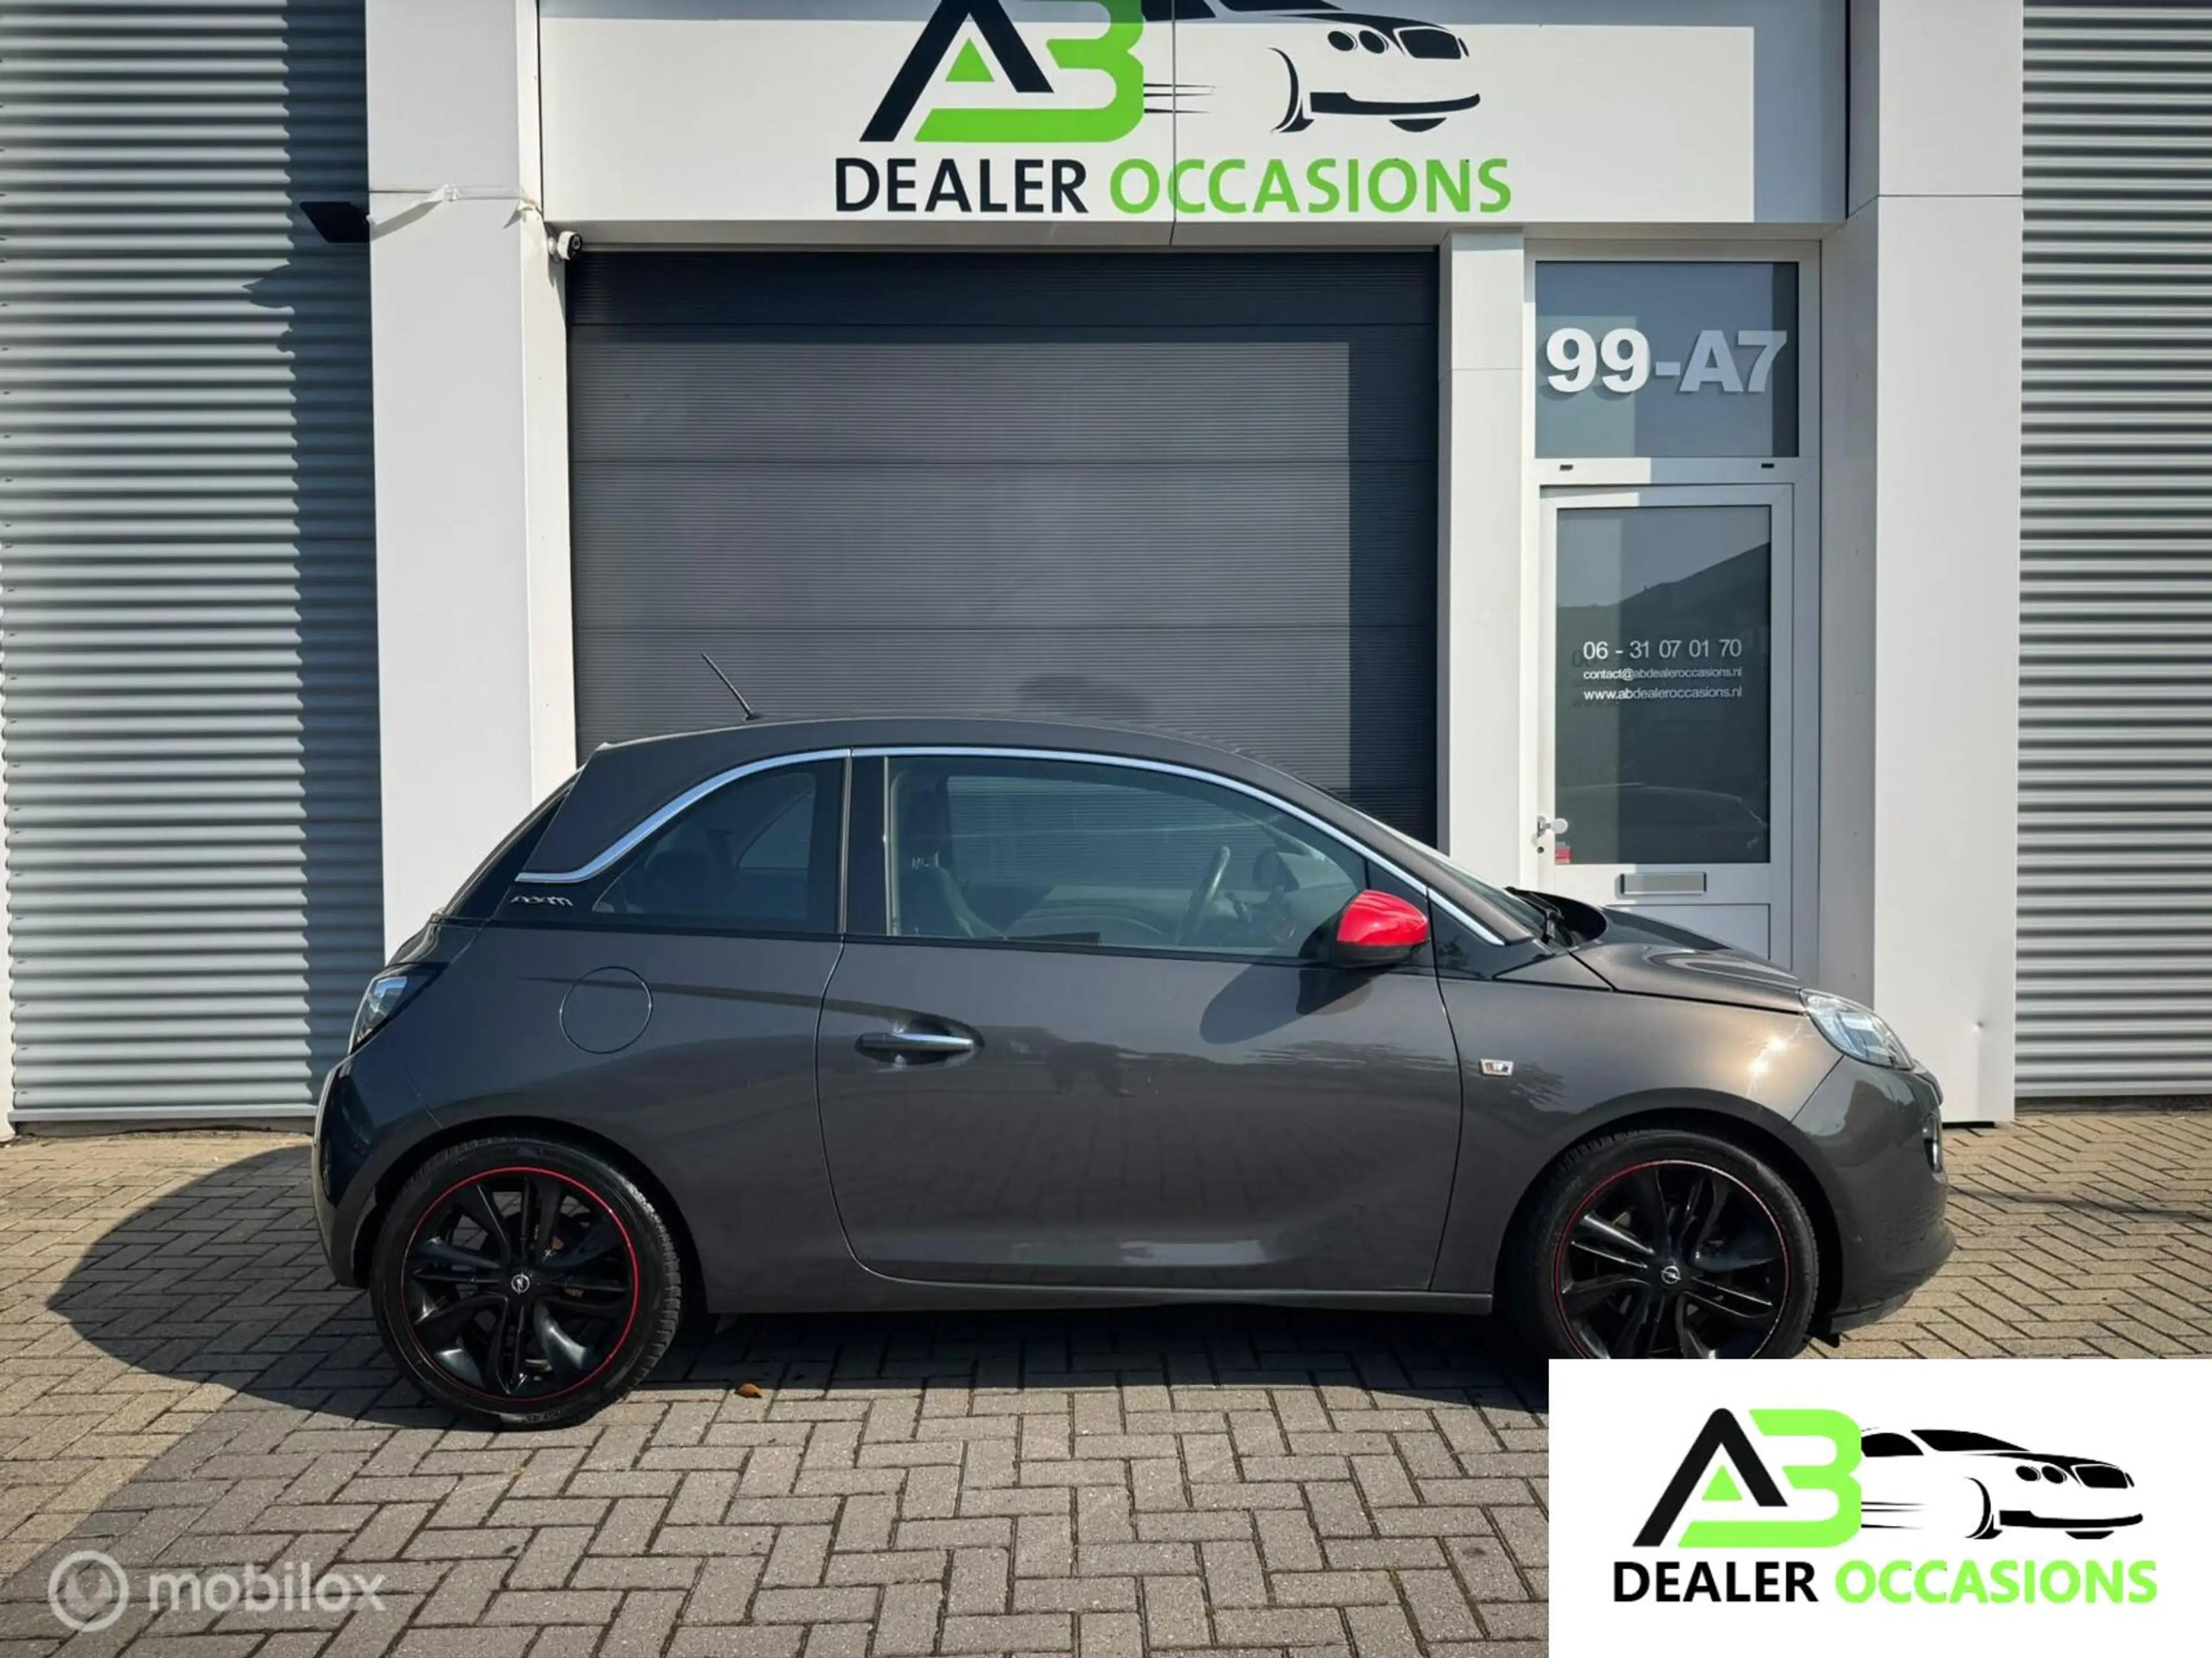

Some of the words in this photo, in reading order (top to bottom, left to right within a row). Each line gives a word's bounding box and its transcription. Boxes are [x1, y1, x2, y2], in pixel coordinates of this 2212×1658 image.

[836, 158, 1089, 214] DEALER
[1109, 158, 1512, 214] OCCASIONS
[1547, 328, 1787, 392] 99-A7
[1584, 641, 1608, 660] 06
[1630, 640, 1649, 658] 31
[1659, 640, 1682, 658] 07
[1689, 639, 1709, 657] 01
[1719, 639, 1742, 657] 70
[1584, 687, 1742, 700] www.abdealeroccasions.nl
